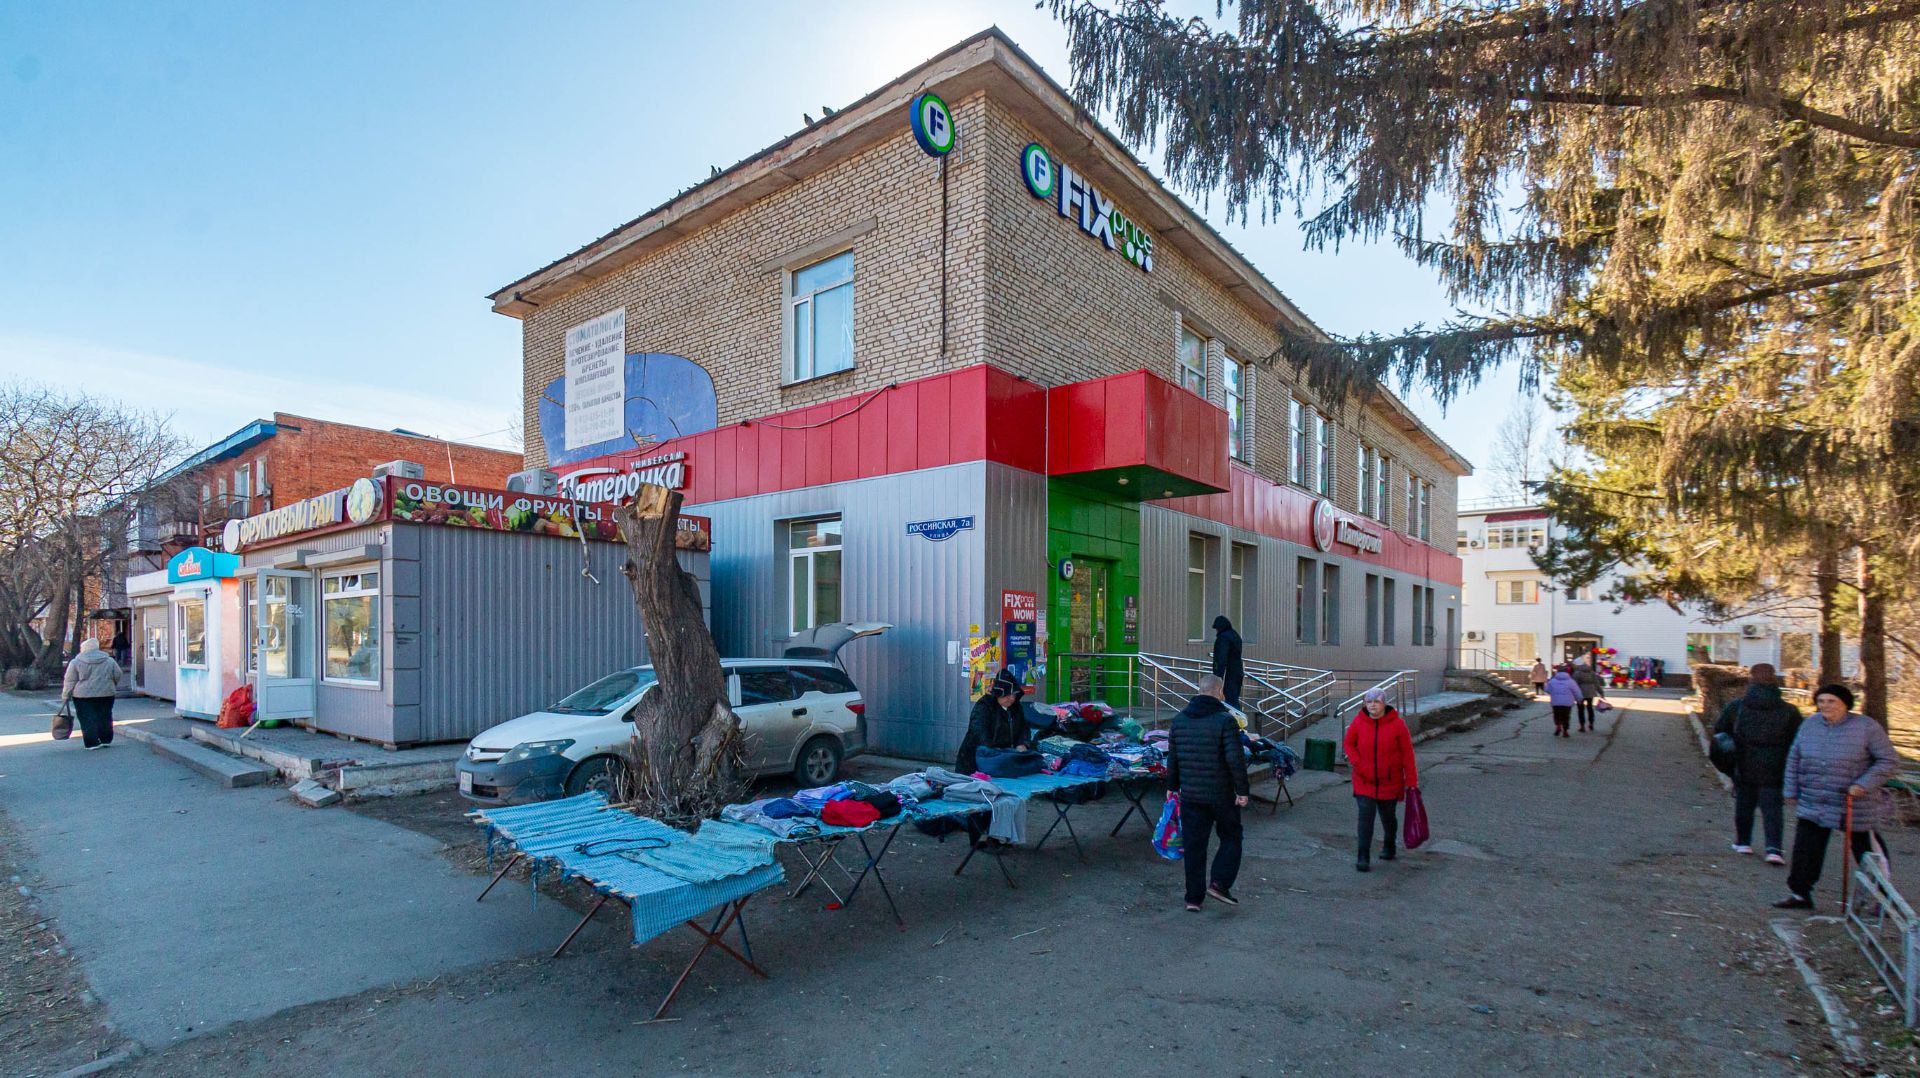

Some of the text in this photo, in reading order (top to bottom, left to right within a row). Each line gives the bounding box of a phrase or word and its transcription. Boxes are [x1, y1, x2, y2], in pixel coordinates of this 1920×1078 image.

[929, 106, 945, 137] F
[1034, 153, 1046, 182] F
[1112, 209, 1153, 255] price
[630, 451, 684, 469] УНИВЕРСАМ
[405, 483, 602, 521] ОВОЩИ ФРУКТЫ
[239, 498, 308, 544] ФРУКТОВЫЙ
[1065, 563, 1072, 576] F
[1004, 593, 1021, 608] FIX
[1013, 609, 1035, 621] WOW!
